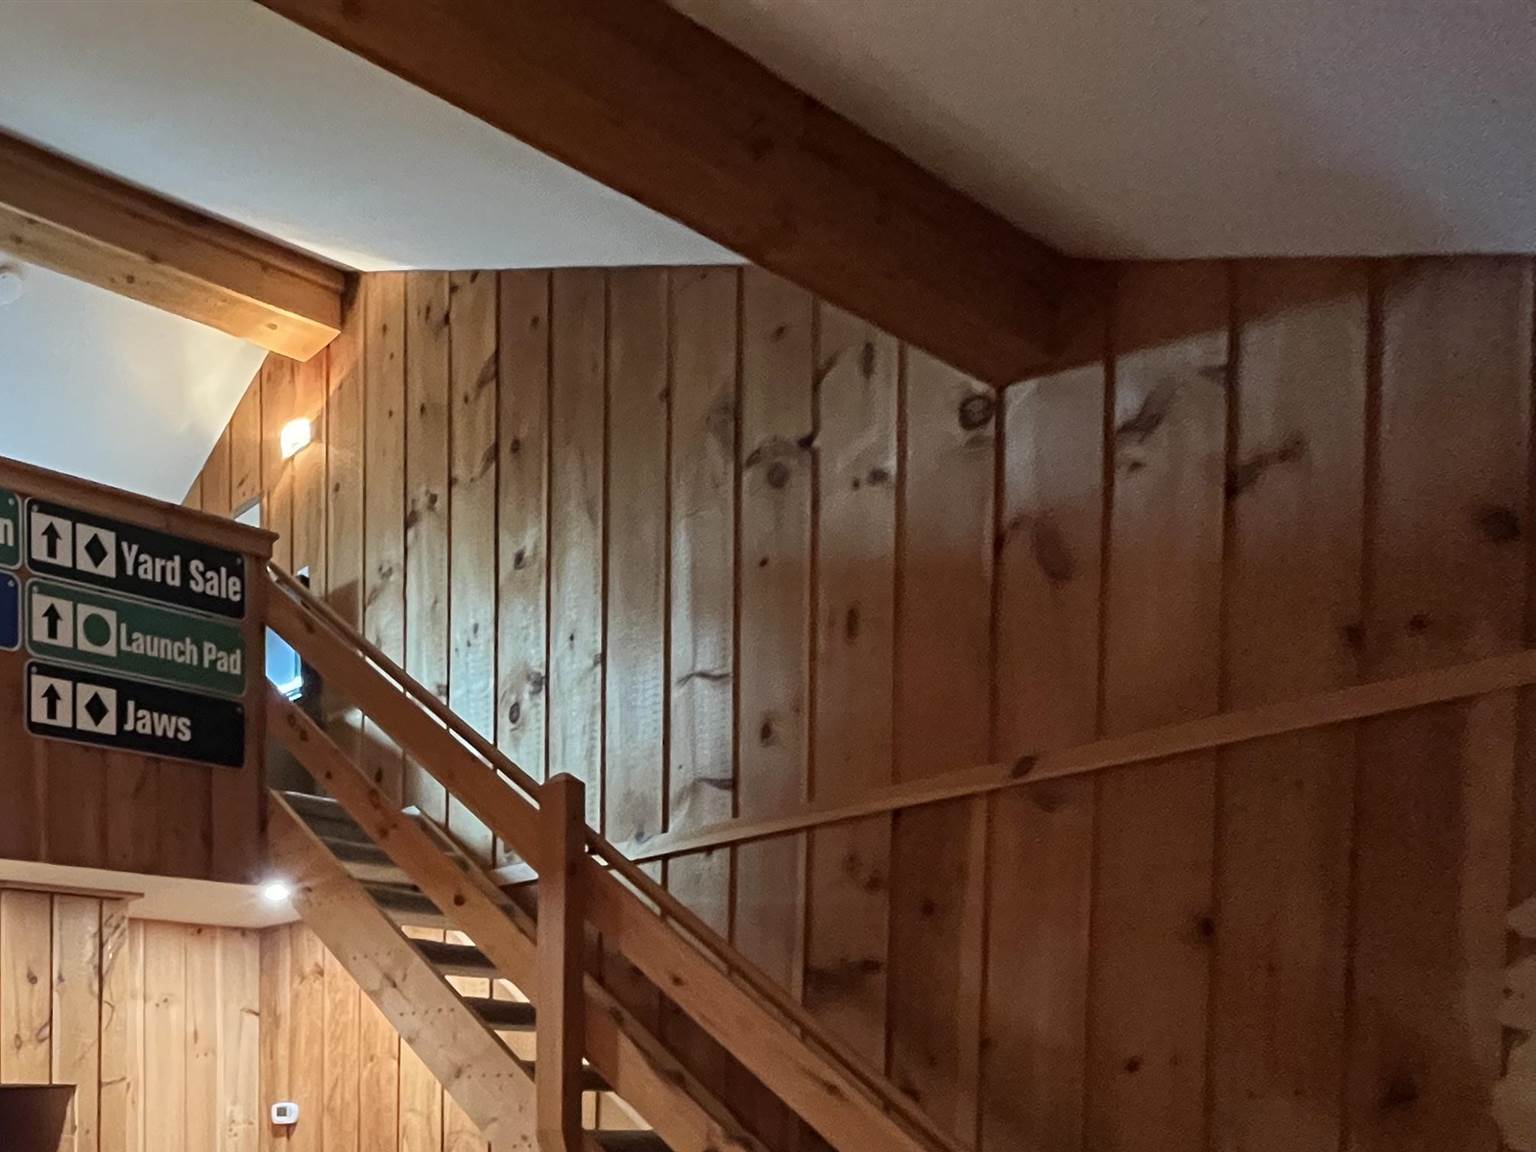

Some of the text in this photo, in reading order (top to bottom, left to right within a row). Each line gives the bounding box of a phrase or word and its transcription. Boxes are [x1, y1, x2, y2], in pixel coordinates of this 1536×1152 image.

[121, 541, 242, 601] Yard Sale
[120, 623, 242, 675] Launch Pad
[123, 701, 191, 742] Jaws
